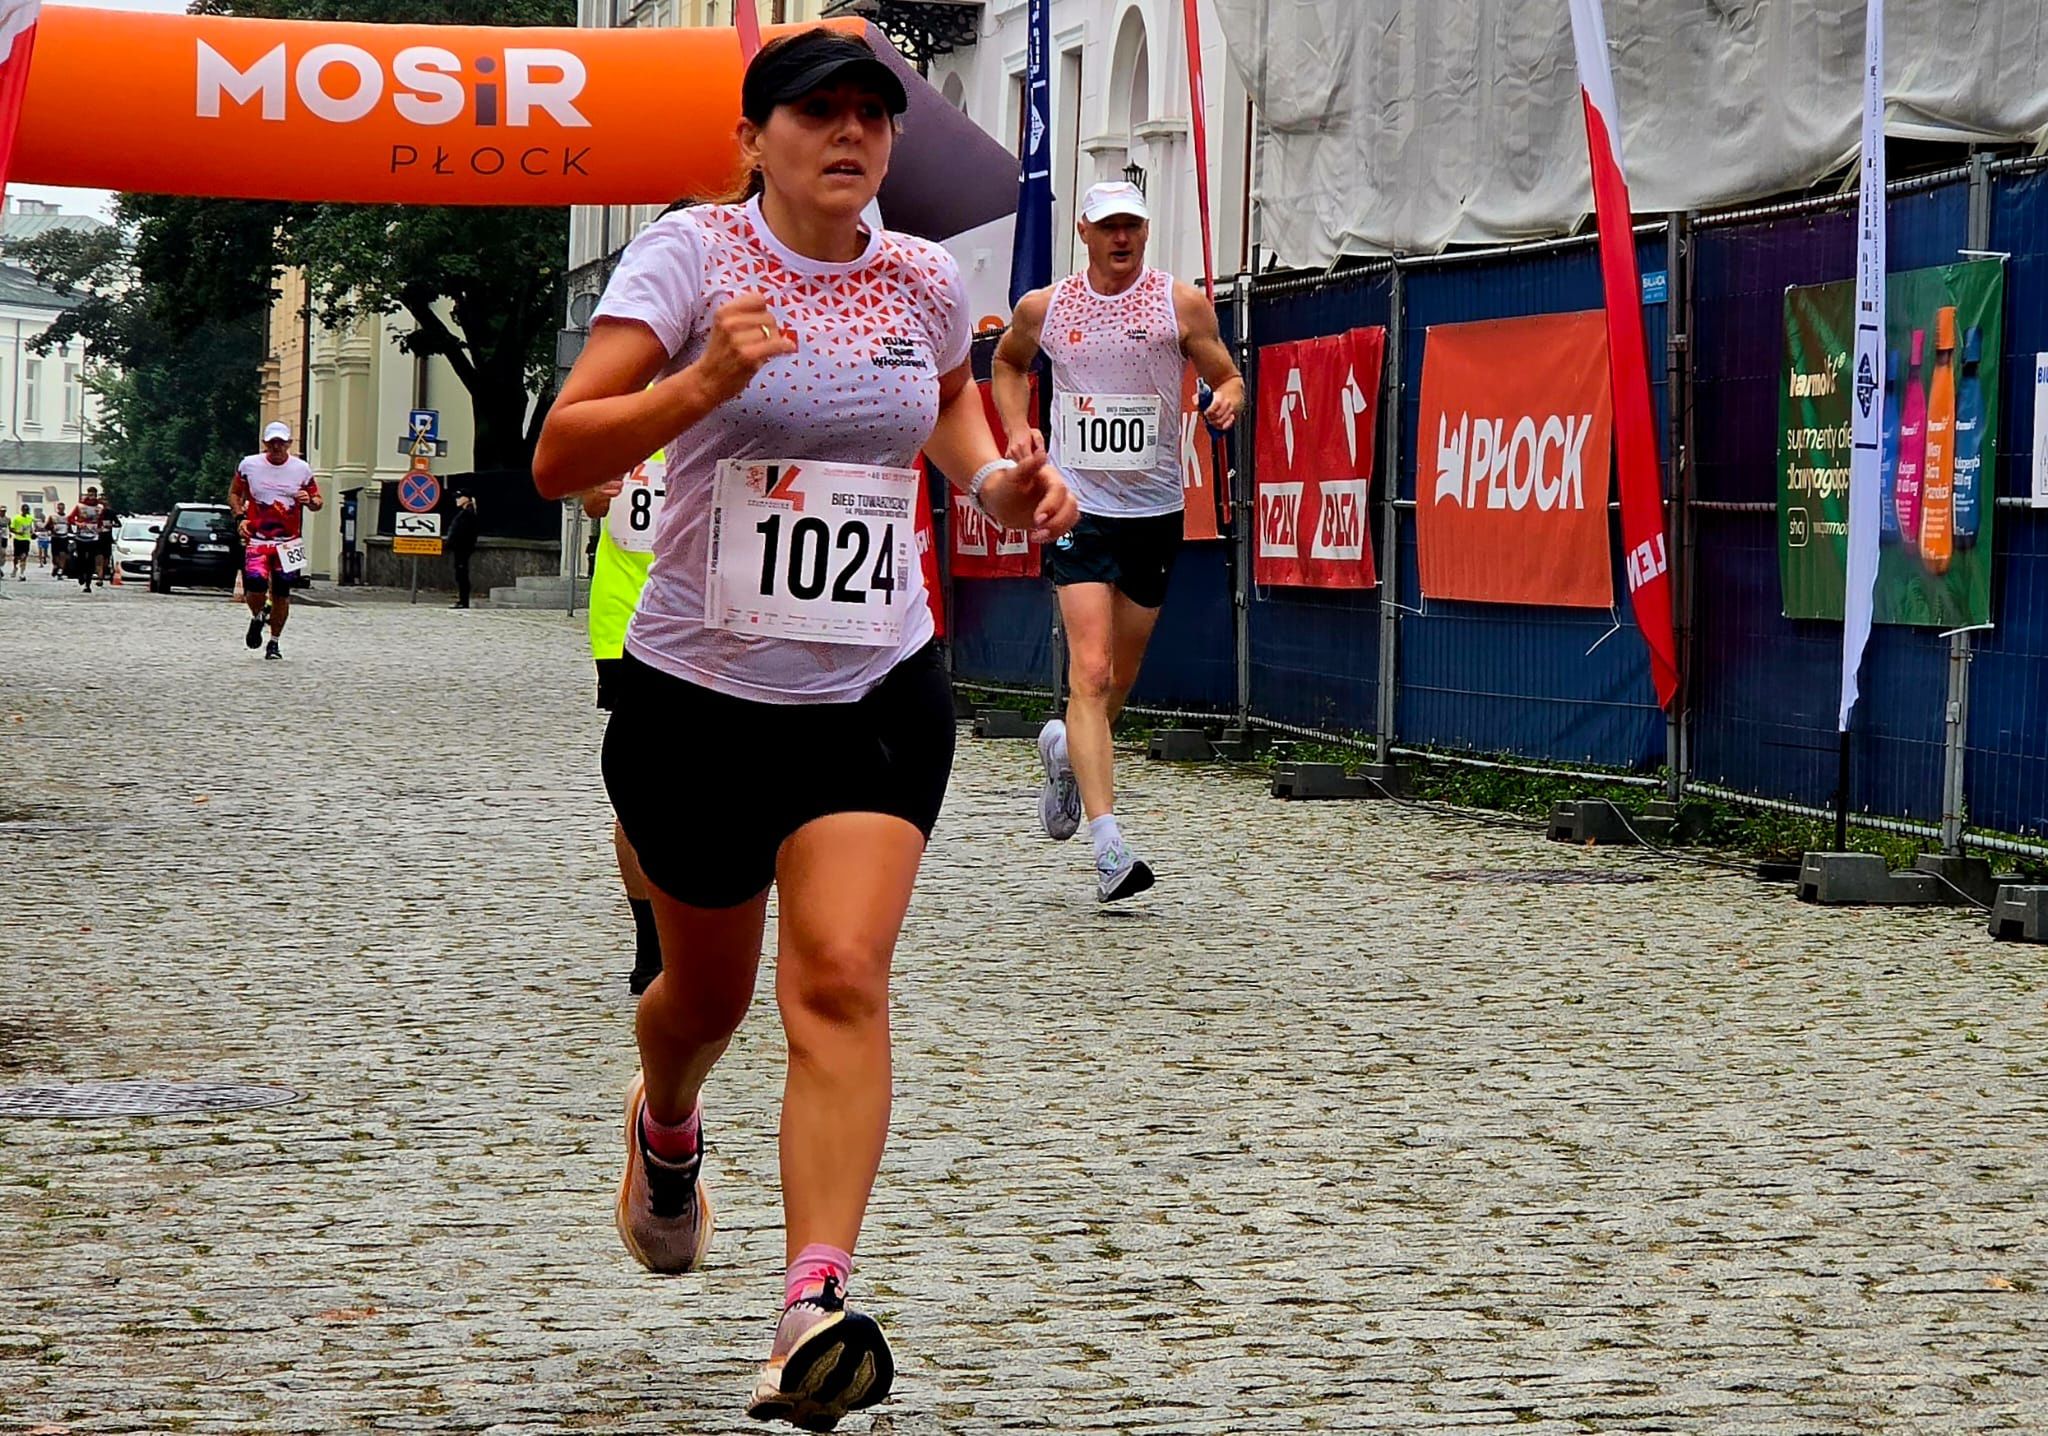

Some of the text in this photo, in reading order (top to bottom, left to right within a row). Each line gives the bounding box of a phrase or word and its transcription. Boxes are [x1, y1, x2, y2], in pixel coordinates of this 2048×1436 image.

[196, 38, 592, 128] MOSiR
[390, 145, 592, 177] PŁOCK
[1077, 416, 1145, 454] 1000
[1466, 413, 1593, 511] PŁOCK
[756, 514, 895, 606] 1024
